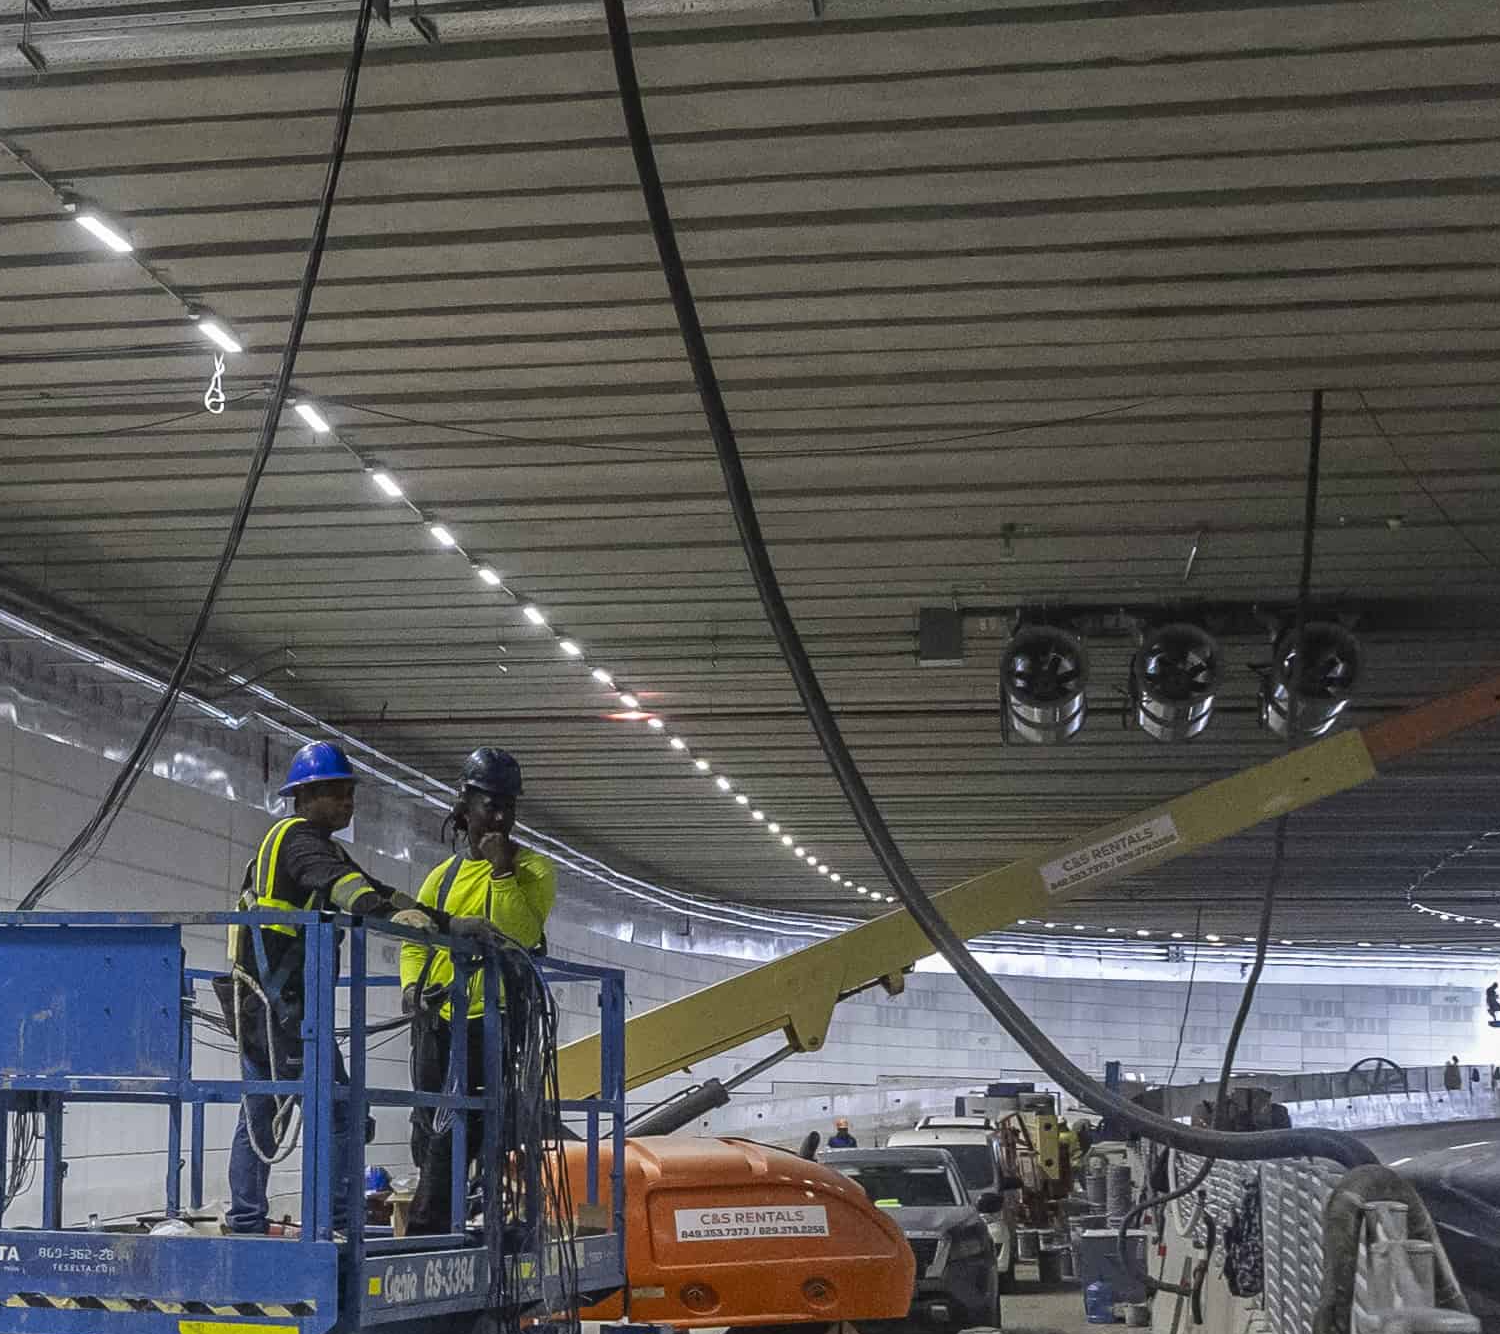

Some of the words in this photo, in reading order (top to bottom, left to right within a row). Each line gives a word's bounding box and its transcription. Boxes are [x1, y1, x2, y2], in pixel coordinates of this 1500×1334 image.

[1091, 827, 1153, 860] RENTALS
[700, 1212, 730, 1225] C&S
[735, 1210, 804, 1223] RENTALS
[384, 1264, 417, 1304] Genie
